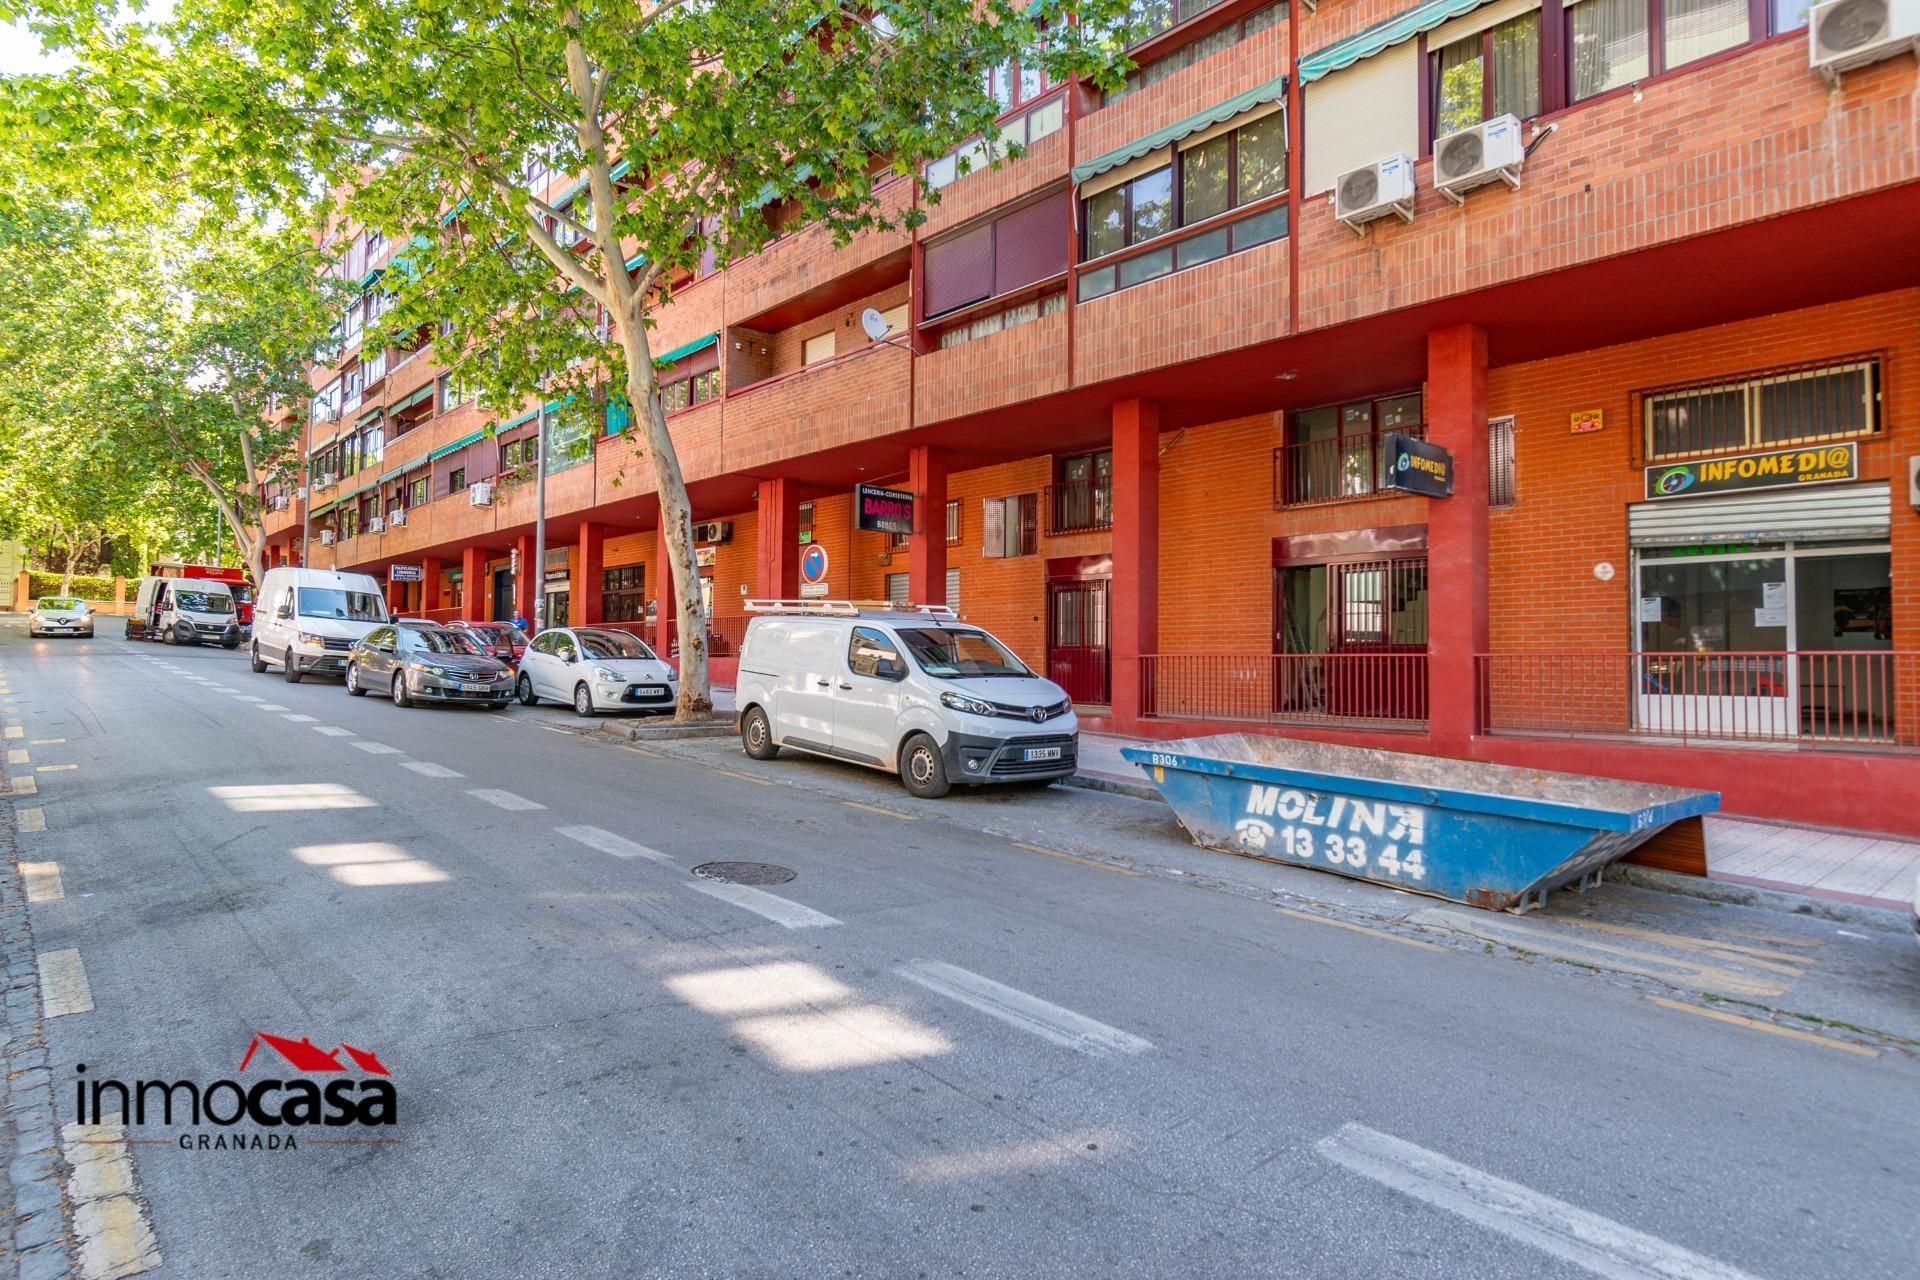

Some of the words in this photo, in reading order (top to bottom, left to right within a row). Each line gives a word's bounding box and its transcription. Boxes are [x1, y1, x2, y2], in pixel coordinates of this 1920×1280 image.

[1700, 447, 1849, 482] INFOMEDI@
[1798, 470, 1848, 482] GRANADA
[864, 498, 911, 519] BARRO'S
[877, 520, 896, 532] BEBES
[1030, 749, 1046, 760] 1335
[1152, 753, 1178, 766] B306
[1246, 784, 1425, 845] MOLINA
[1281, 825, 1314, 858] 13
[1325, 833, 1367, 868] 33
[1378, 844, 1426, 880] 44
